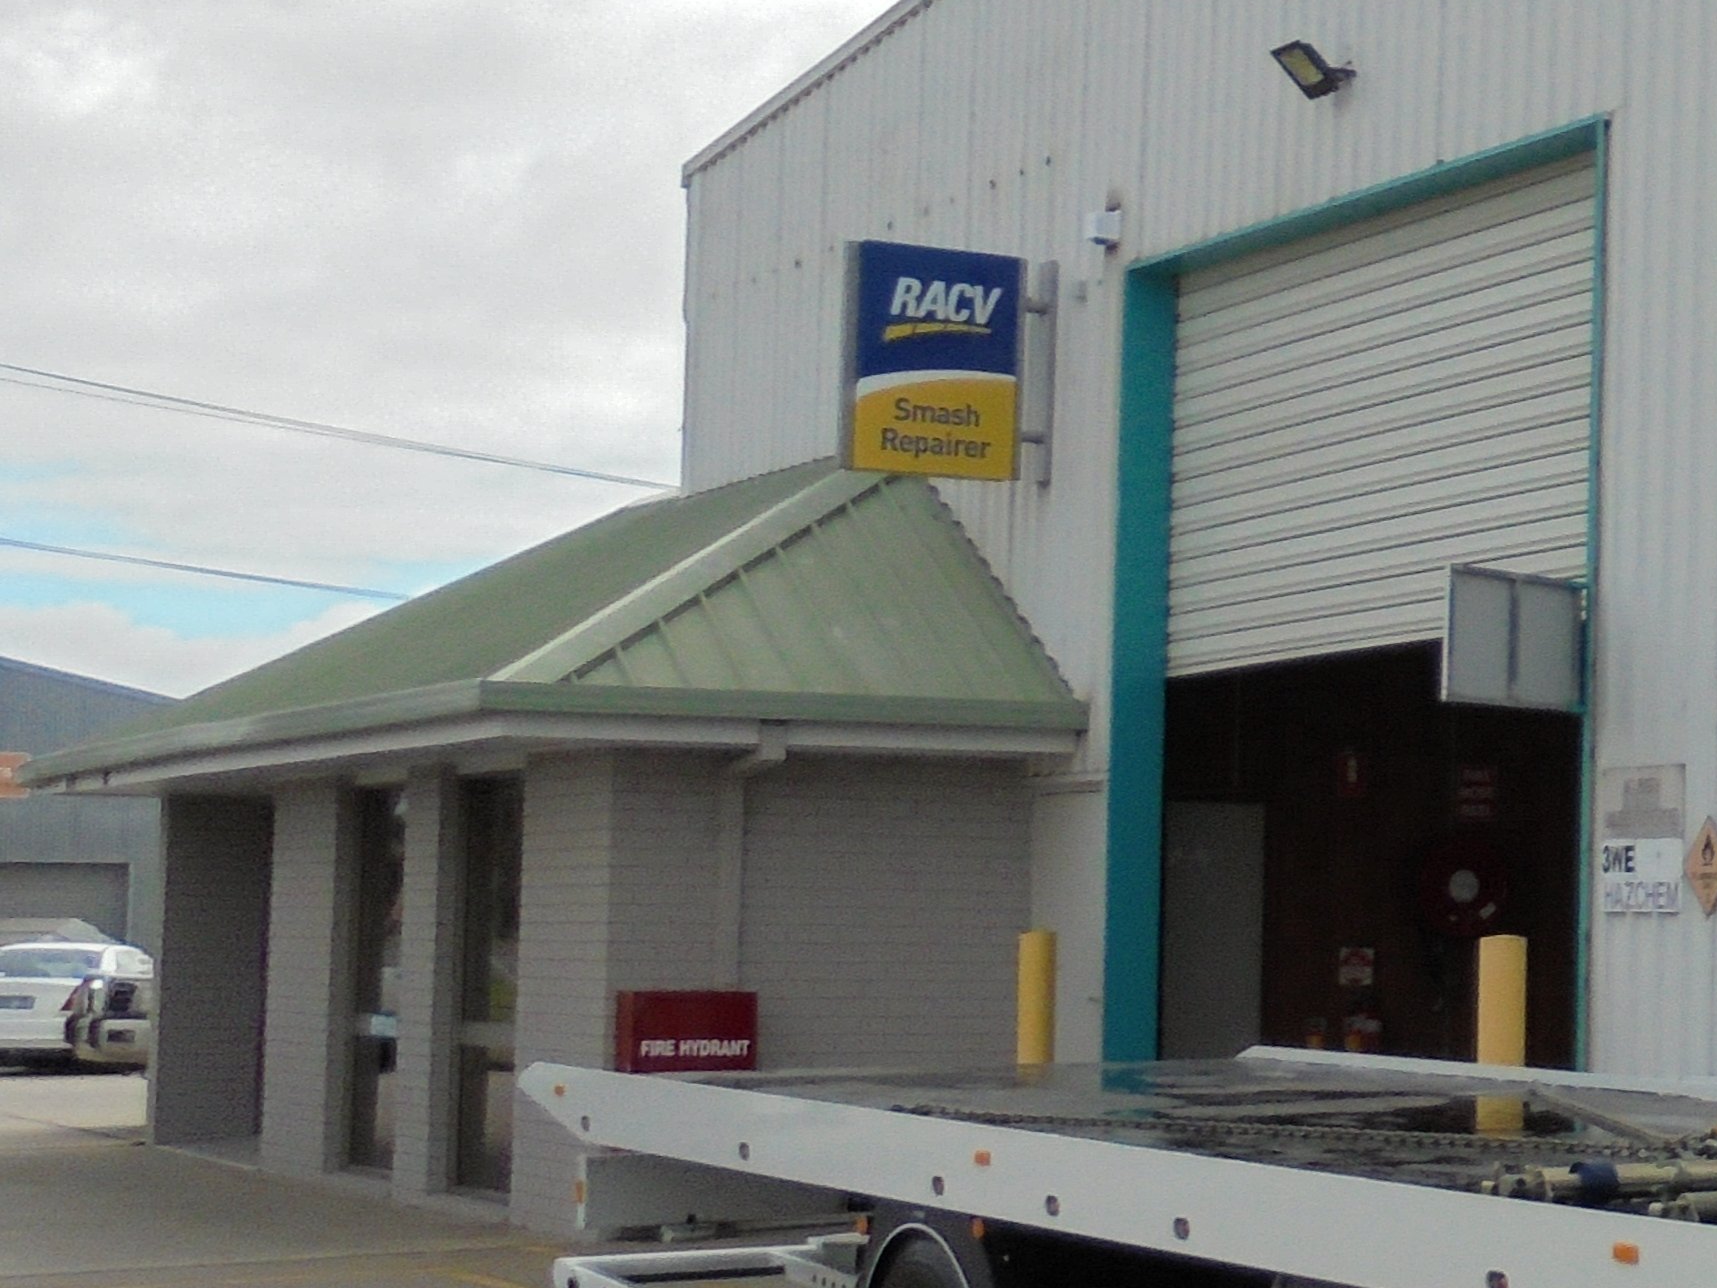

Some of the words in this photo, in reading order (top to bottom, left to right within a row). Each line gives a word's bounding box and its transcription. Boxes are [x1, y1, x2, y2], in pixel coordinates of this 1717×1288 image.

[889, 276, 1002, 325] RACV
[894, 397, 981, 428] Smash
[881, 427, 991, 459] Repairer
[640, 1039, 677, 1057] FIRE
[679, 1039, 750, 1057] HYDRANT
